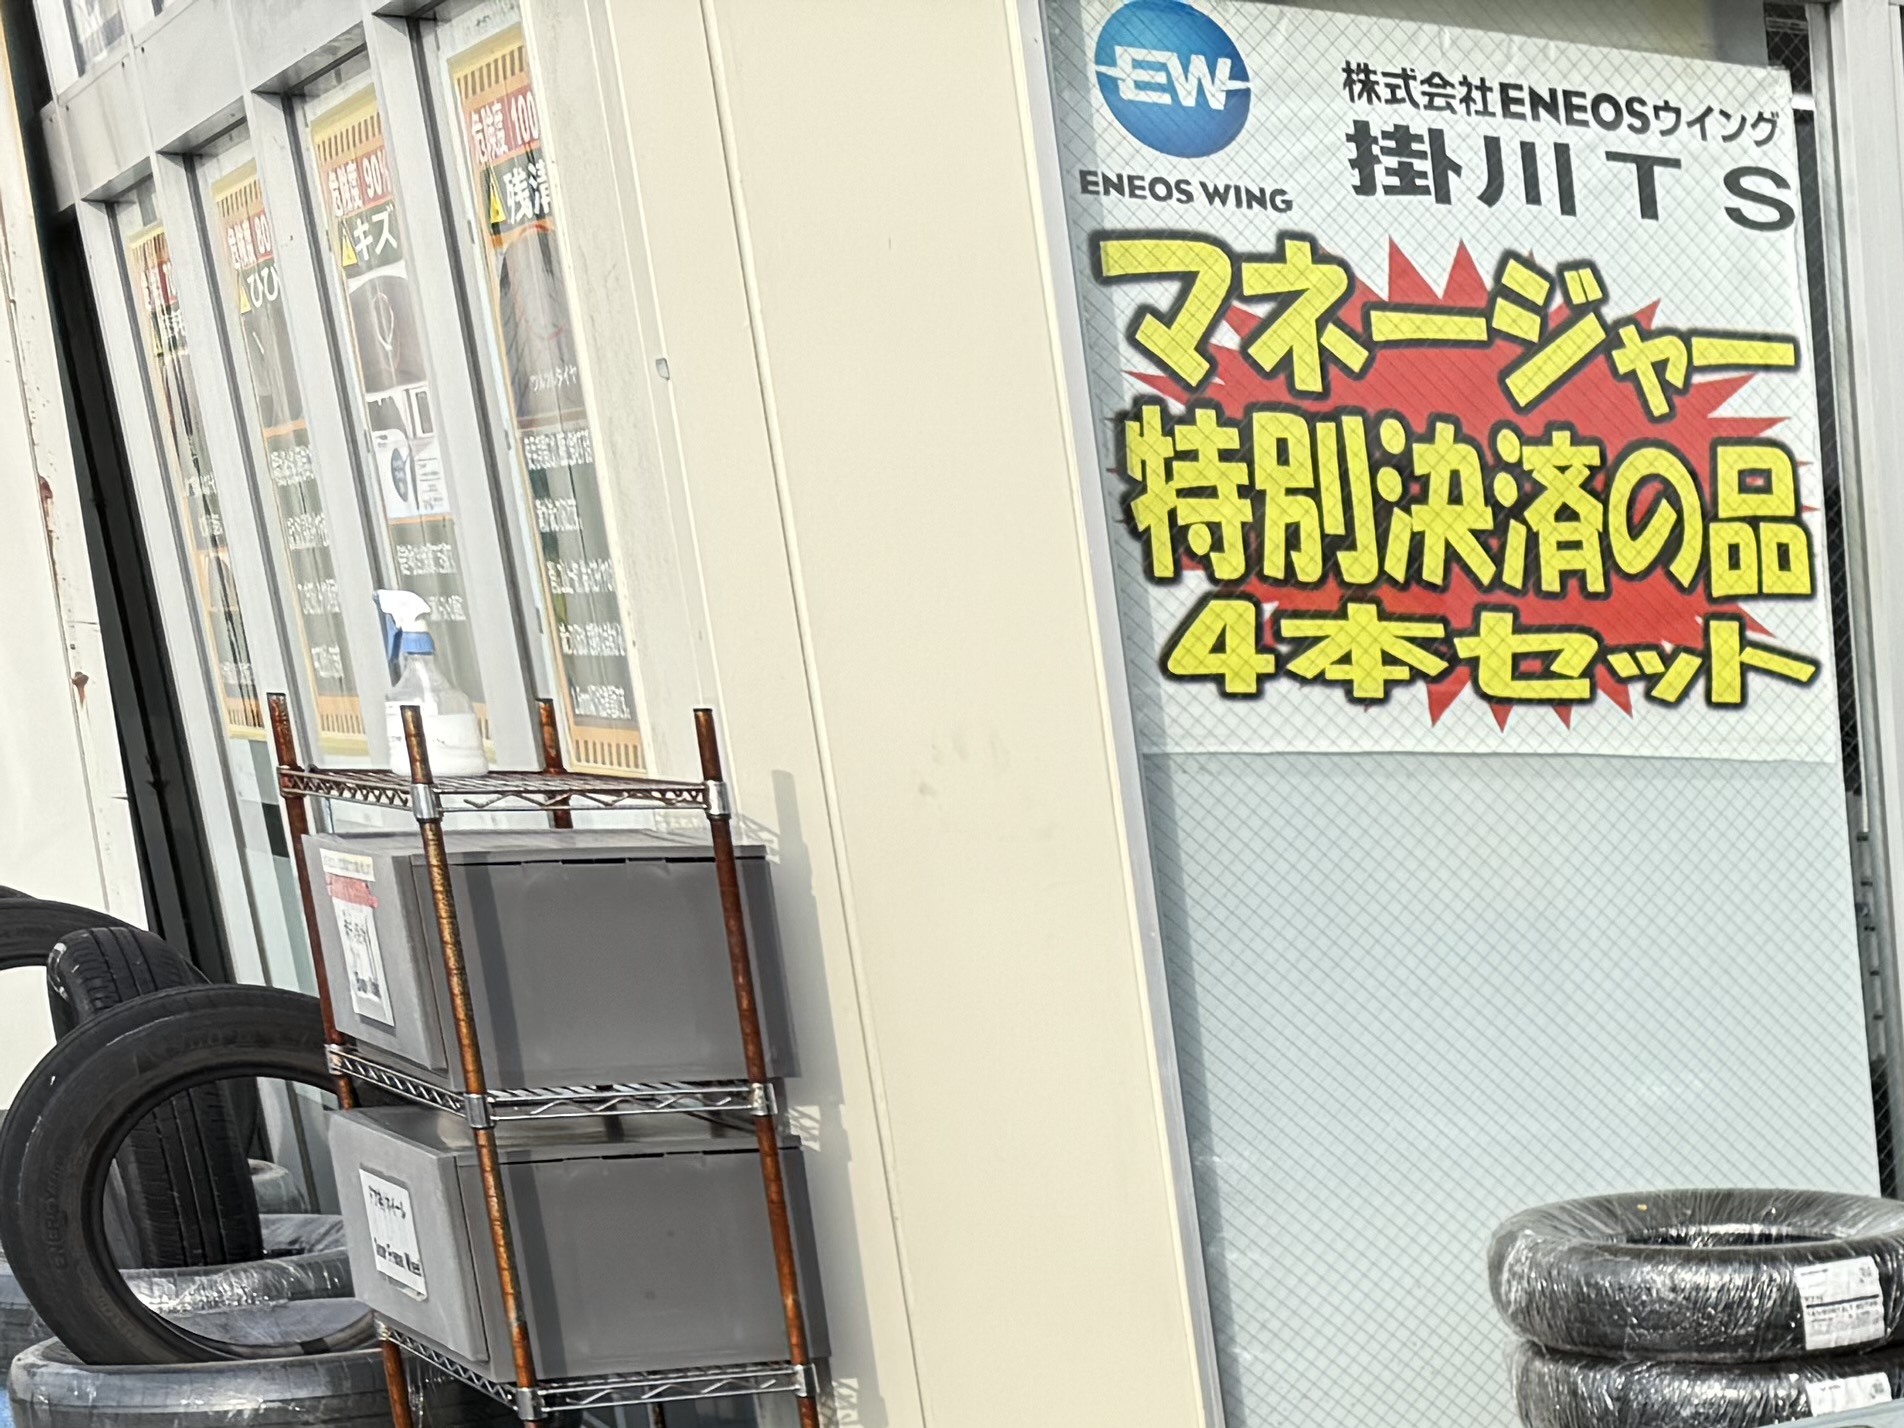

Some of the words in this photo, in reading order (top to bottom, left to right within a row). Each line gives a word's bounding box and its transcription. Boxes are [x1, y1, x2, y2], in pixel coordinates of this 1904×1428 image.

[1341, 59, 1781, 148] 株式会社ENEOSウイング
[353, 204, 398, 262] キズ
[1079, 168, 1194, 204] ENEOS
[1200, 179, 1294, 215] WING
[1089, 231, 1803, 421] マネージャー
[1119, 401, 1818, 600] 特別決済の品
[1159, 598, 1822, 706] 4本セット
